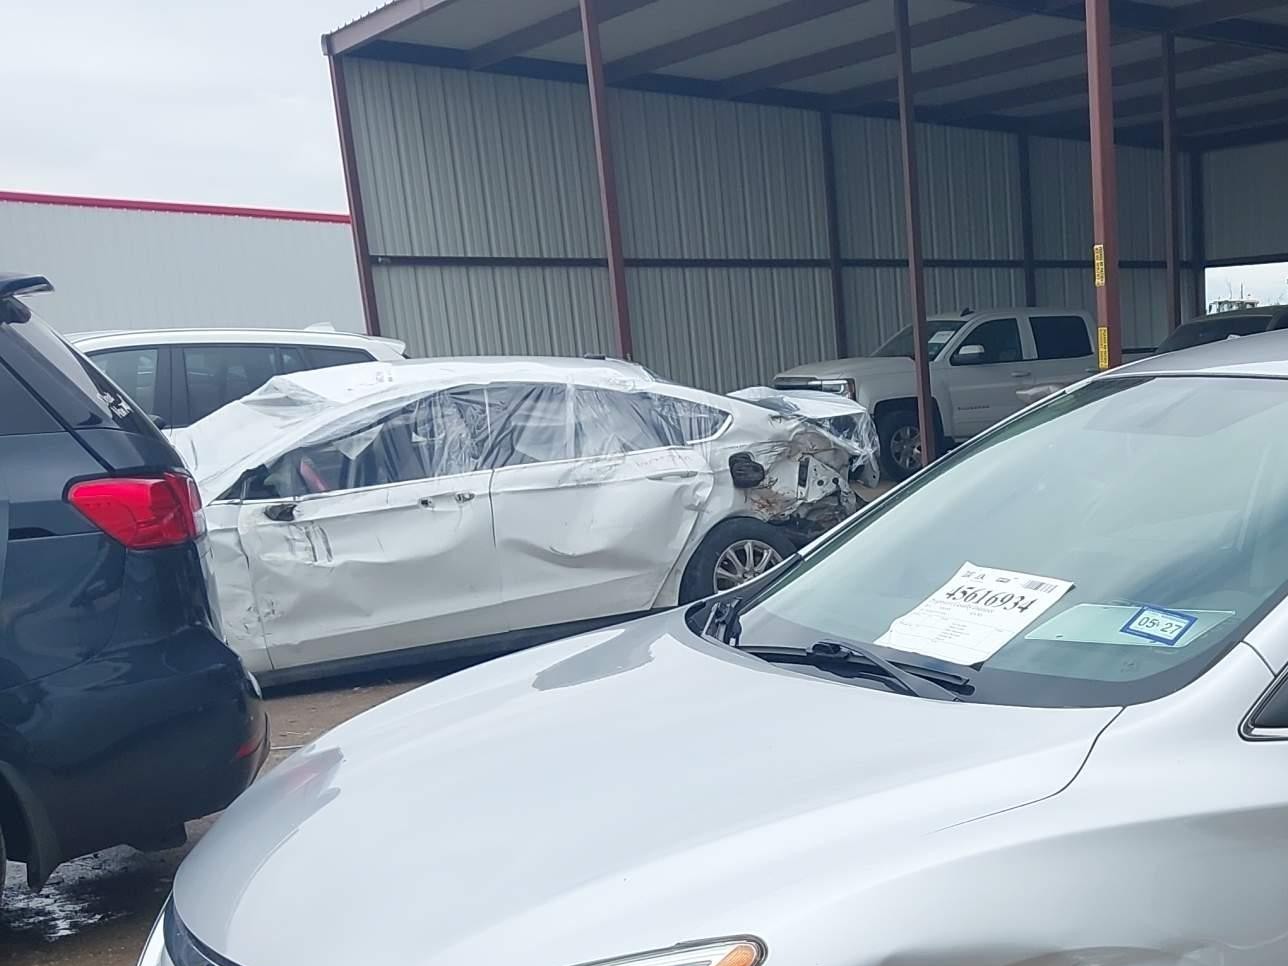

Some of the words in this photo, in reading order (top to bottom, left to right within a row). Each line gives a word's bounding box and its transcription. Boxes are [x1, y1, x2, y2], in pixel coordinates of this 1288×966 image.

[945, 585, 1039, 613] 45616934
[1138, 616, 1159, 629] 05
[1160, 622, 1183, 634] 27
